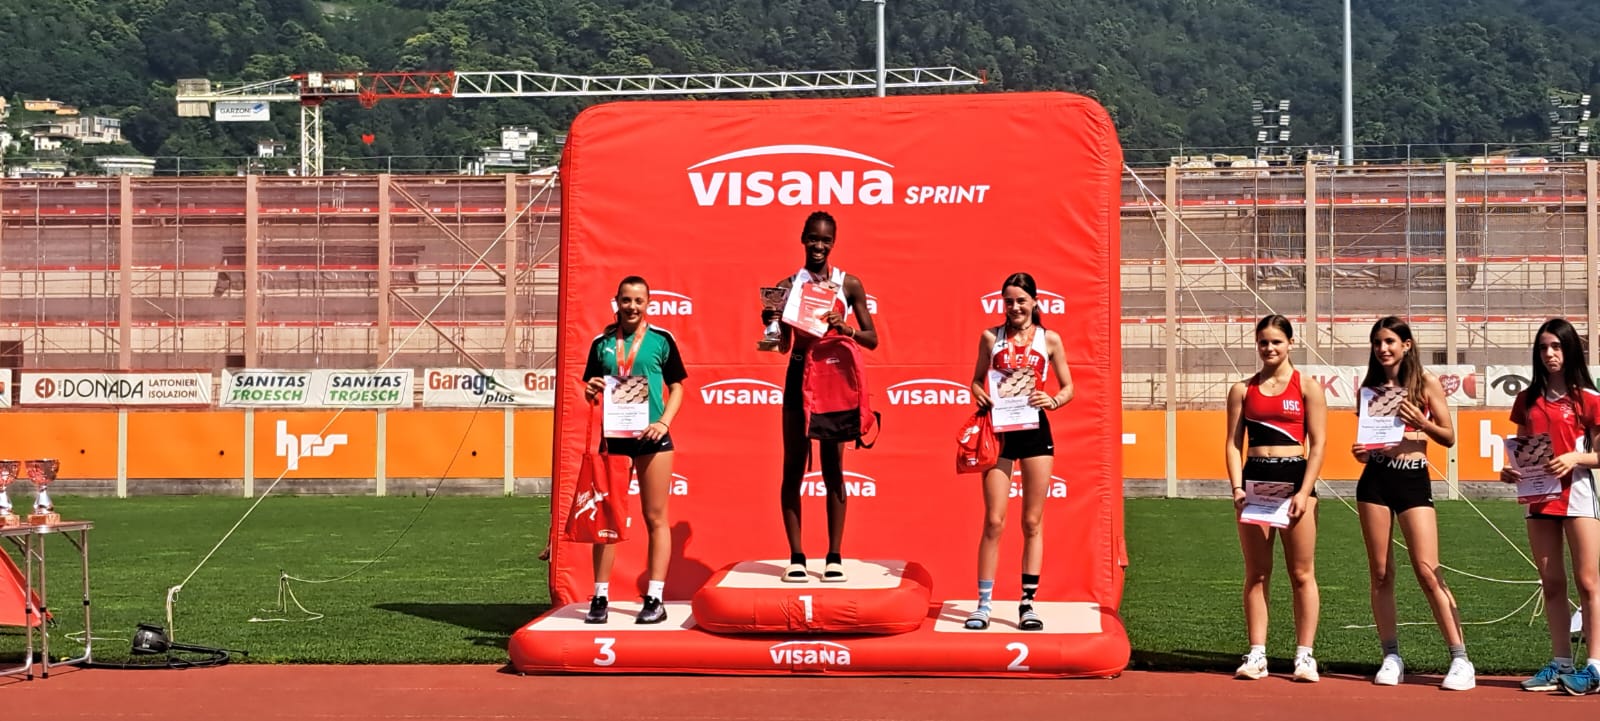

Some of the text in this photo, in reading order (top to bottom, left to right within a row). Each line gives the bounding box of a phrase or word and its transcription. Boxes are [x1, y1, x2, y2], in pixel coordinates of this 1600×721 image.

[904, 185, 990, 205] SPRINT
[149, 379, 198, 388] LATTONIERI
[235, 375, 306, 388] SANITAS
[332, 375, 403, 388] SANITAS
[429, 371, 496, 395] Garage
[64, 379, 143, 398] DONADA
[149, 389, 198, 399] ISOLAZIONI
[232, 389, 303, 401] TROESCH
[329, 390, 399, 402] TROESCH
[485, 392, 515, 404] plus
[1283, 399, 1300, 411] USC
[276, 420, 348, 470] hrs
[1387, 457, 1420, 470] NIKE
[799, 595, 813, 623] 1
[593, 637, 616, 666] 3
[1005, 642, 1030, 671] 2
